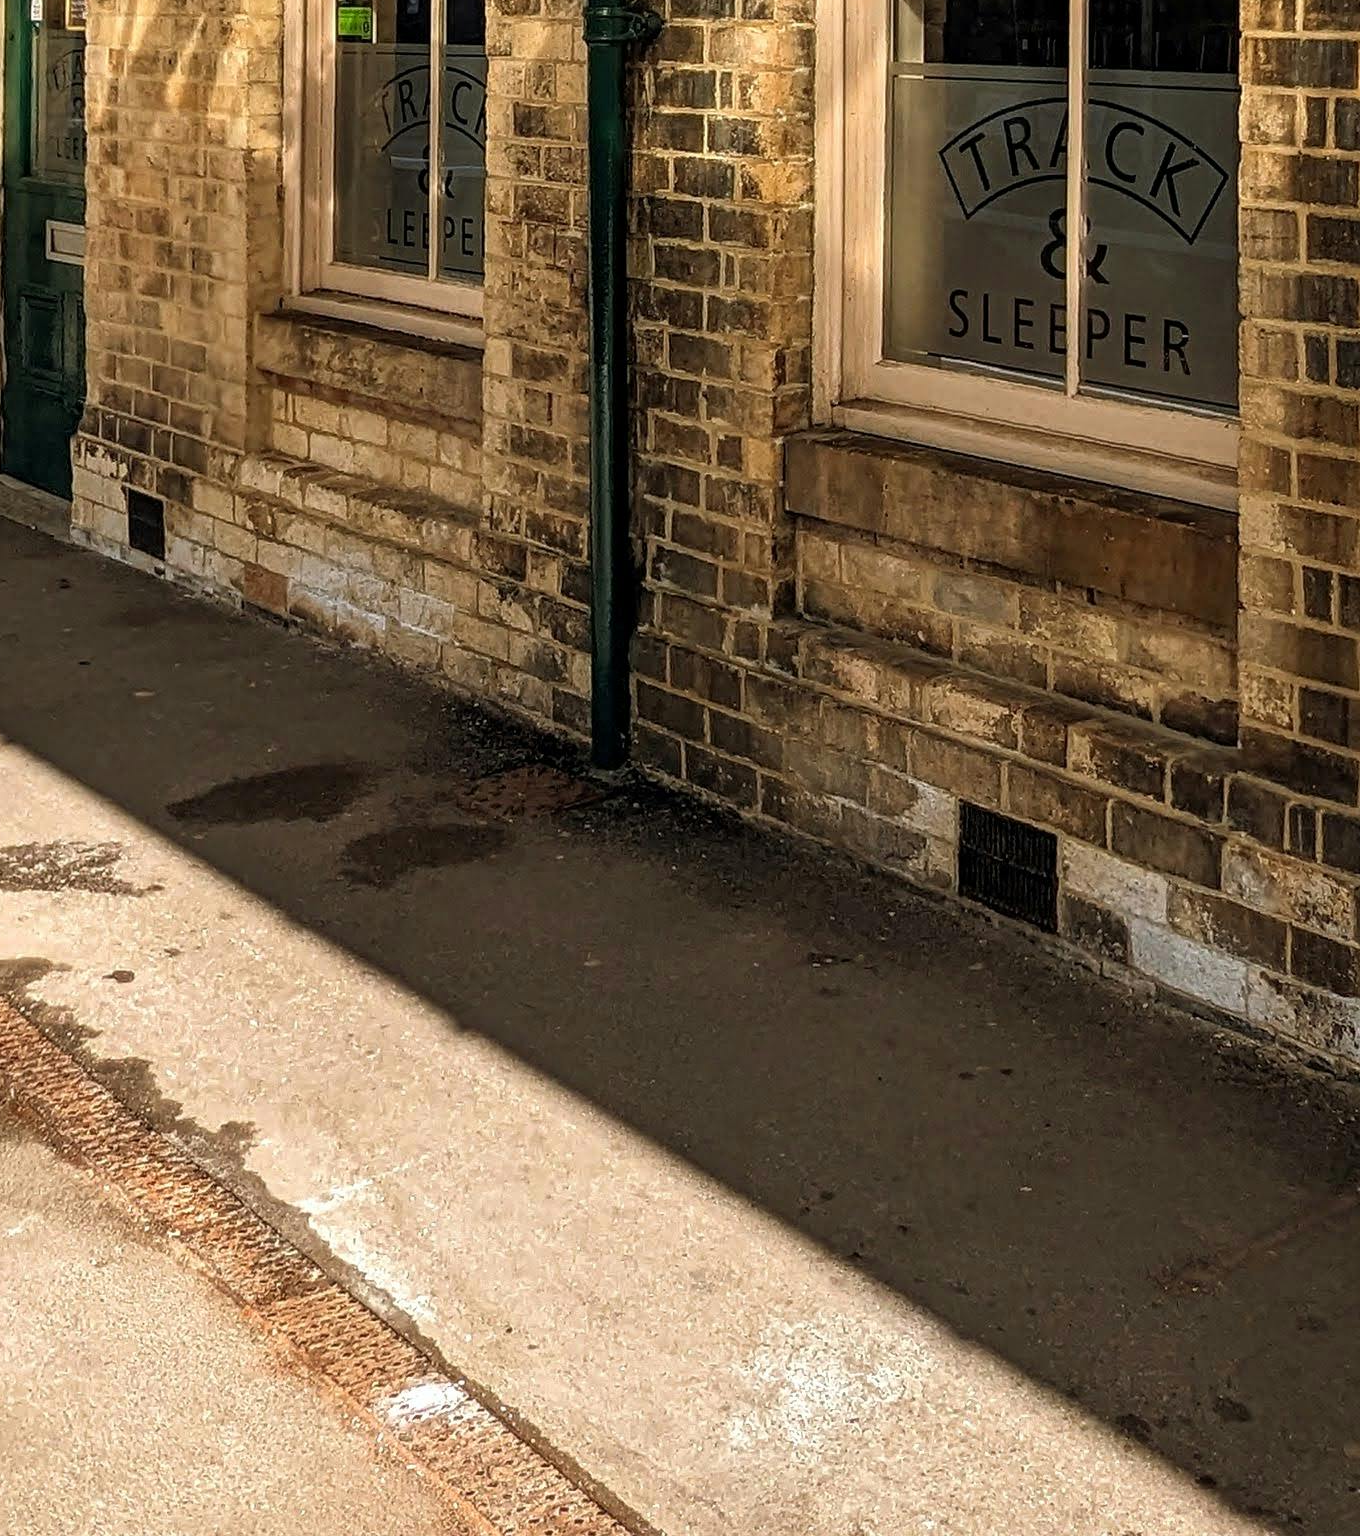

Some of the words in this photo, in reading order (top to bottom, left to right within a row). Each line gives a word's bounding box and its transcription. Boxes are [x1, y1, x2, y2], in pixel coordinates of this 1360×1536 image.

[958, 107, 1200, 218] TRACK
[386, 208, 485, 258] LEEPE
[948, 288, 1191, 376] SLEEPER
